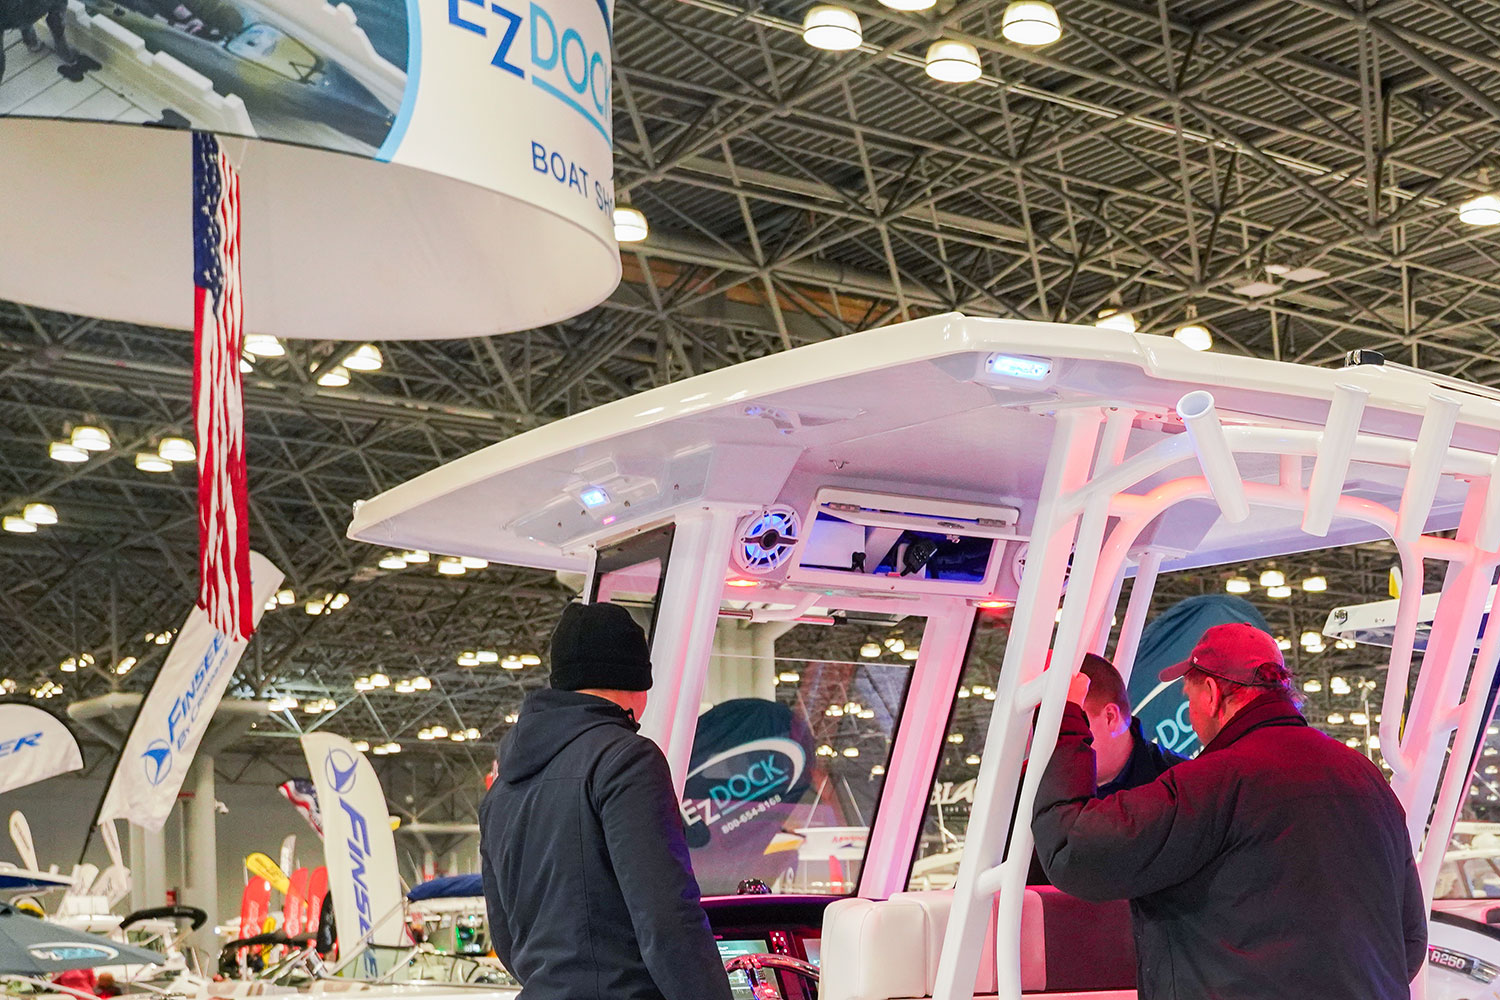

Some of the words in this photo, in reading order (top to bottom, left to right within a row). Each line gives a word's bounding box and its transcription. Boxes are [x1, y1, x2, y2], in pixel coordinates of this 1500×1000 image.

[531, 140, 588, 198] BOAT
[594, 180, 613, 218] SH
[680, 754, 786, 827] EZDOCK
[1430, 950, 1466, 969] R250
